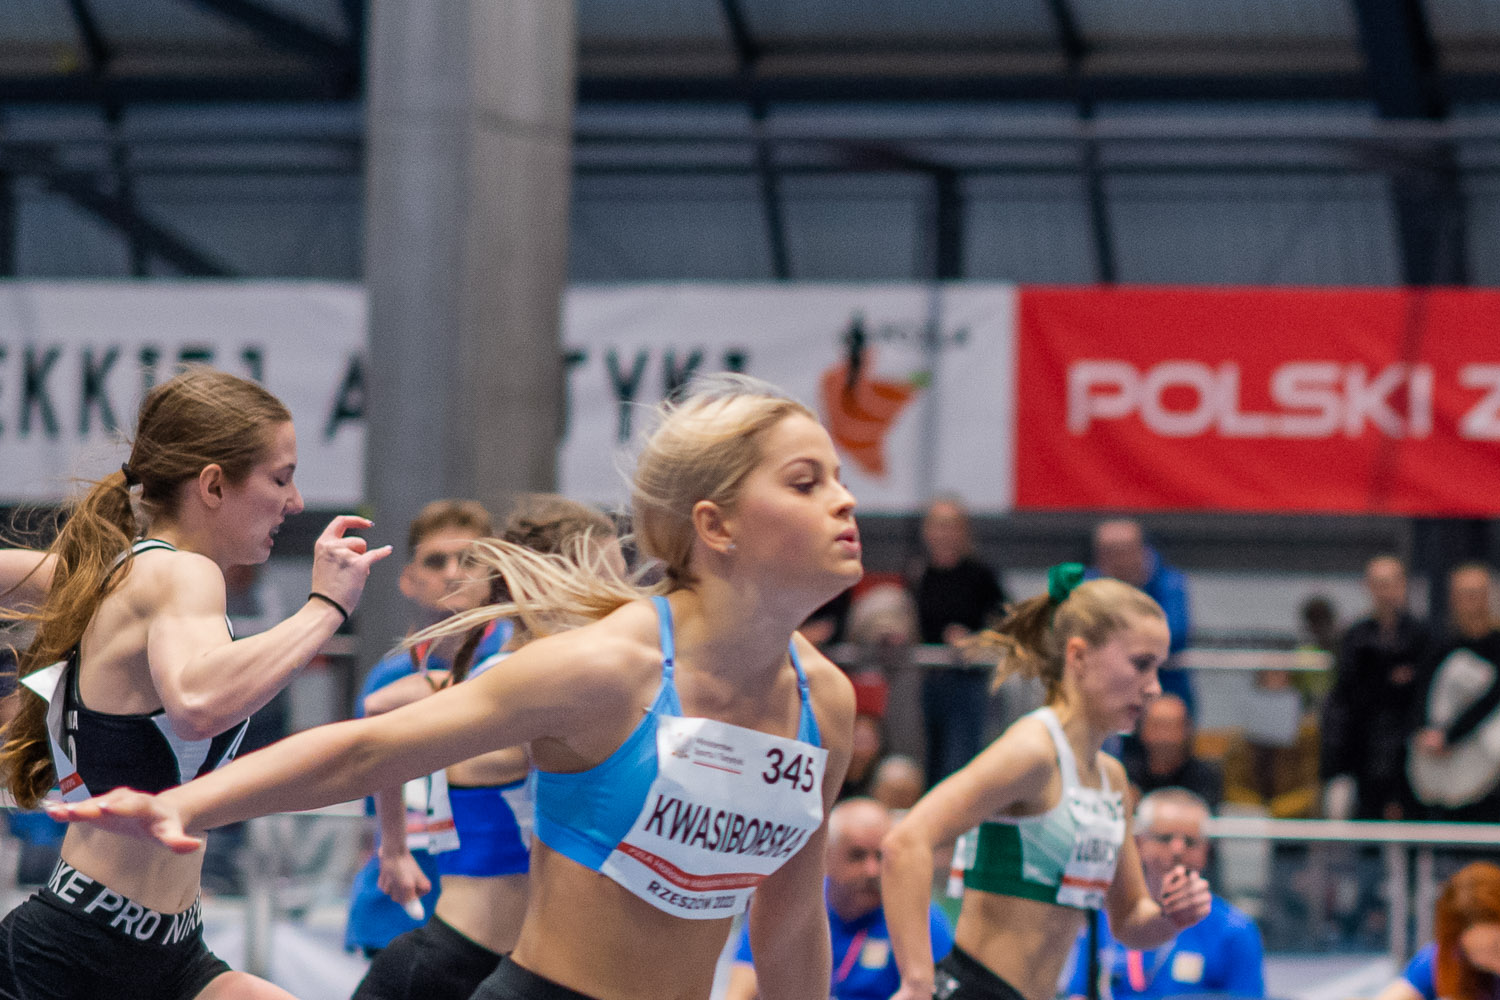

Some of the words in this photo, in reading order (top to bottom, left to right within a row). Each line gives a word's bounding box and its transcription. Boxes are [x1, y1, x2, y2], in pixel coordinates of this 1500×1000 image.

[1066, 359, 1433, 440] POLSKI
[762, 748, 814, 792] 345
[644, 794, 807, 858] KWASIBORSKA
[83, 886, 162, 941] PRO
